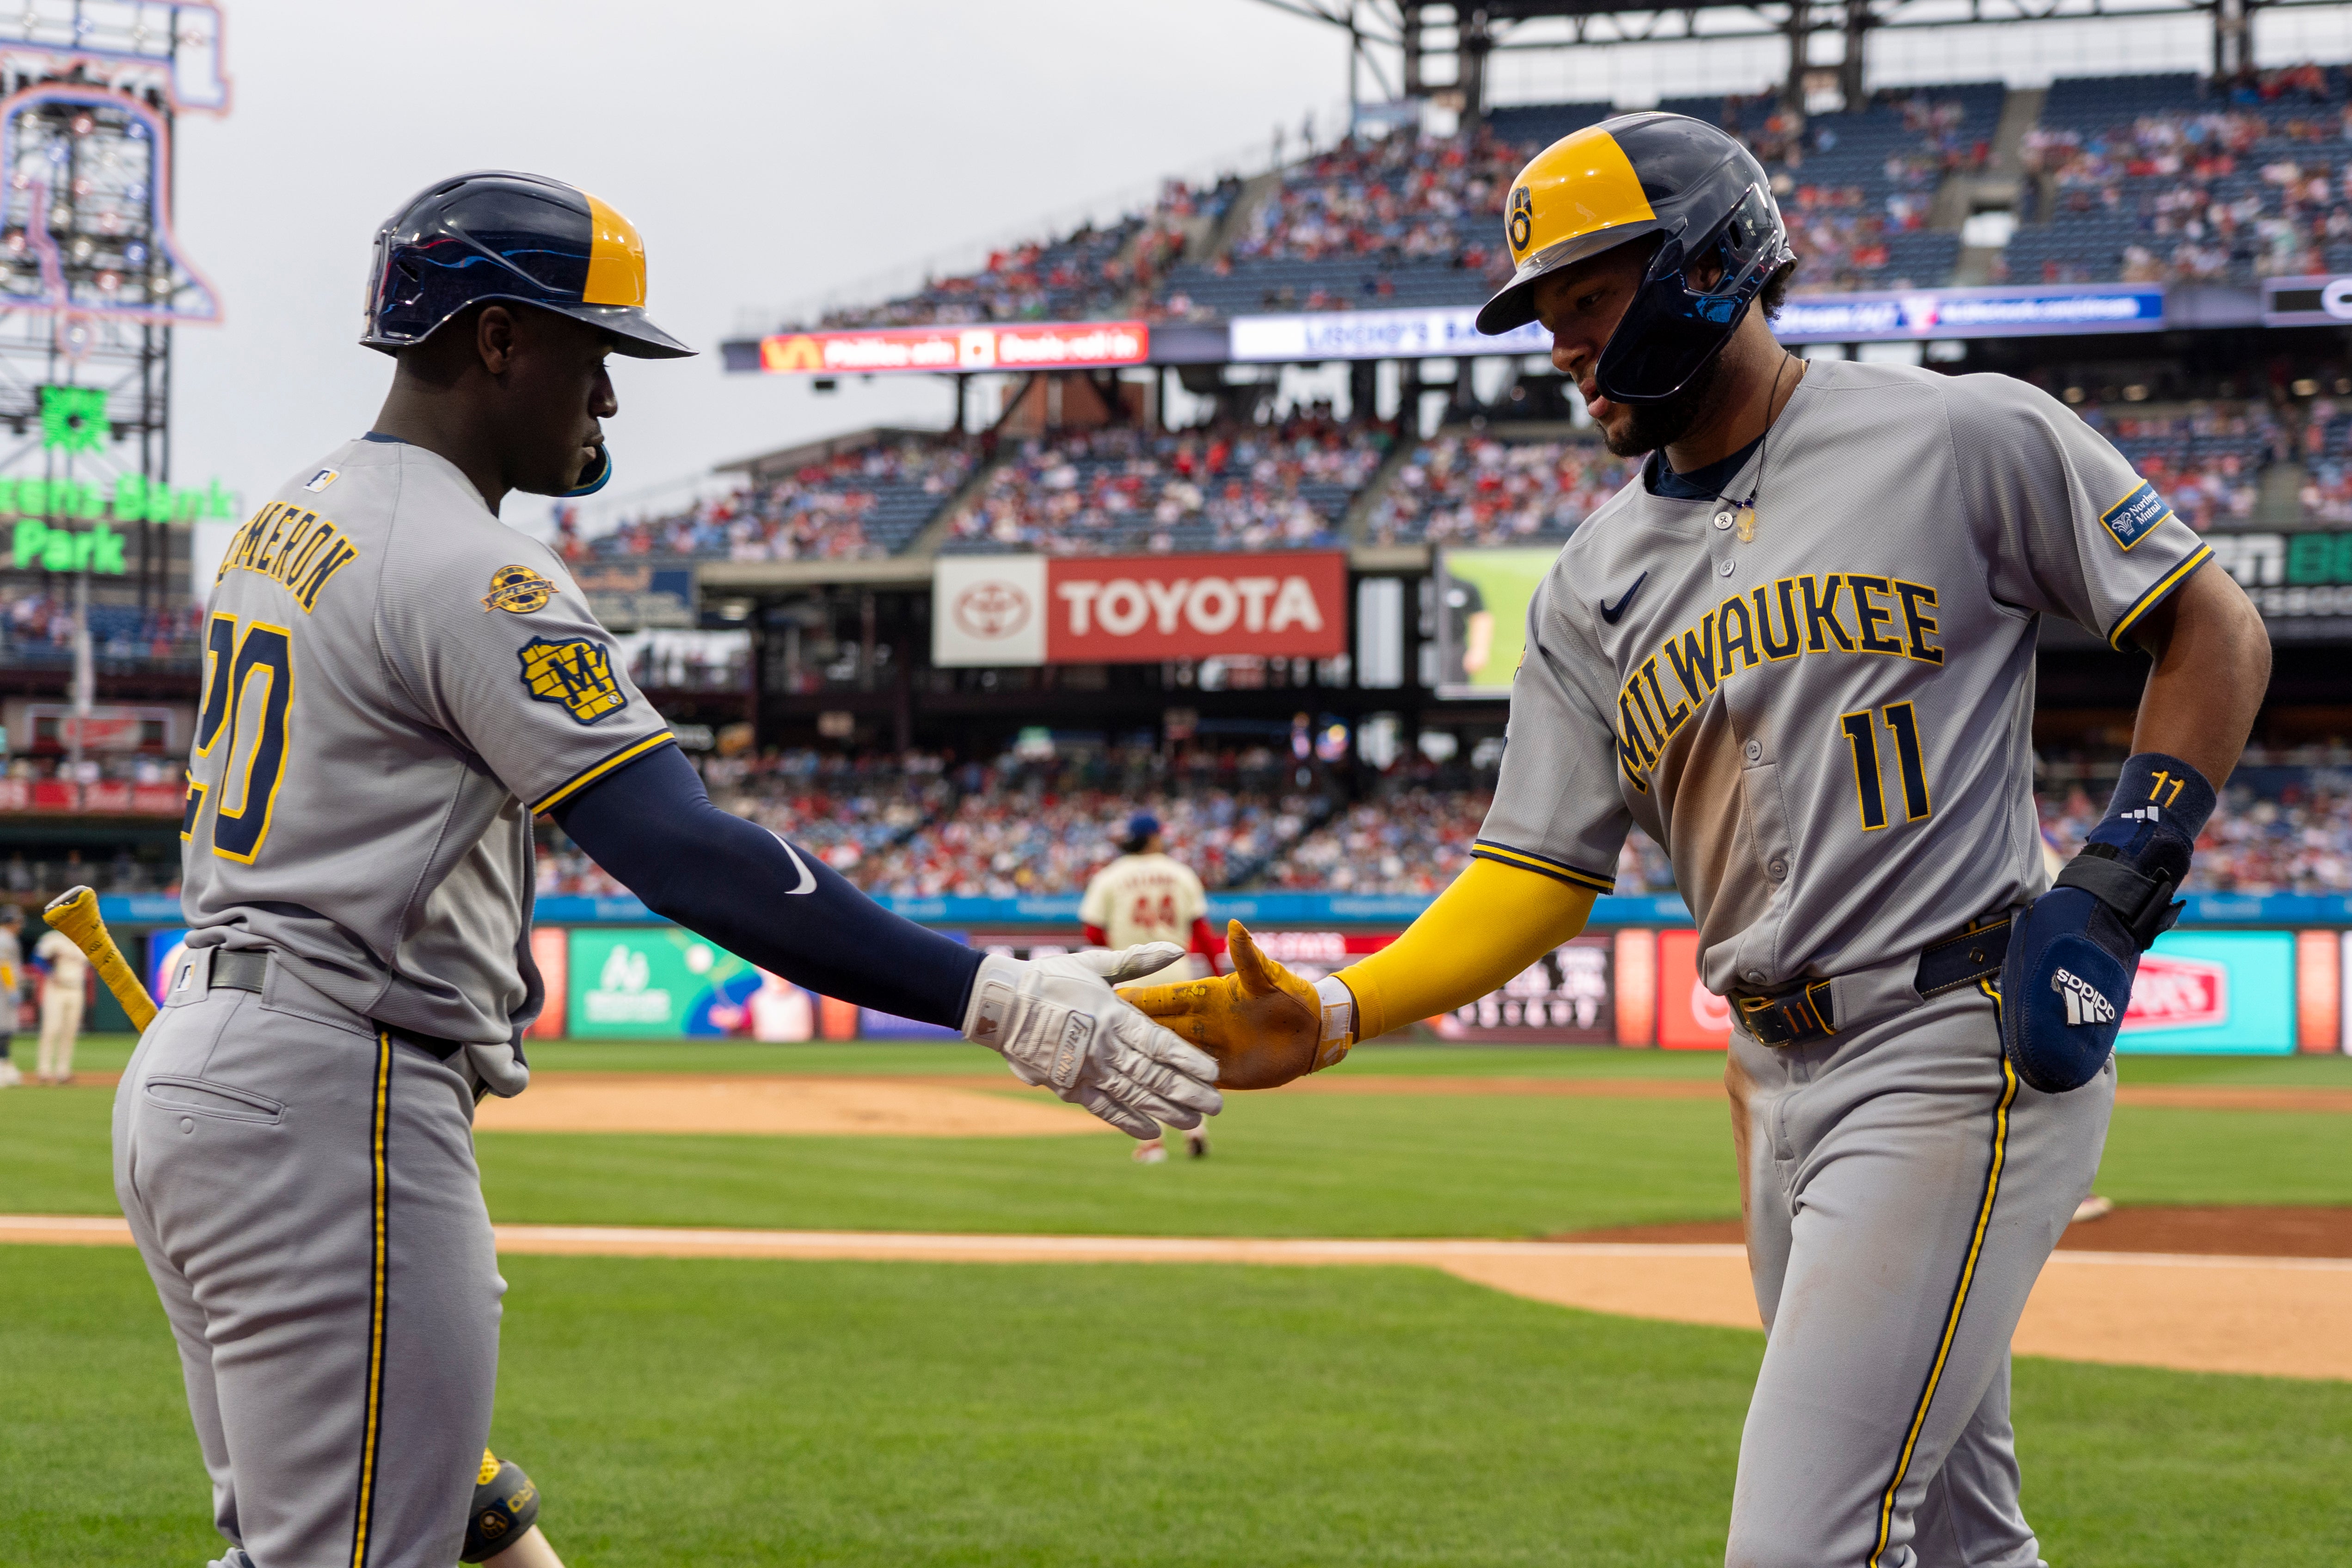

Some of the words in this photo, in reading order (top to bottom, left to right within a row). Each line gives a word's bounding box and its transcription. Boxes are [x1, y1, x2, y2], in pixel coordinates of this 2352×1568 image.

[114, 471, 233, 523] Bank
[2136, 500, 2162, 525] Mutual
[12, 517, 127, 575] Park
[1057, 576, 1324, 637] TOYOTA
[1617, 572, 1944, 795] MILWAUKEE
[1840, 700, 1931, 831] 11
[2151, 771, 2185, 808] 11
[1131, 894, 1176, 928] 44
[1783, 1002, 1813, 1033] 11
[2057, 968, 2115, 1020] adidas
